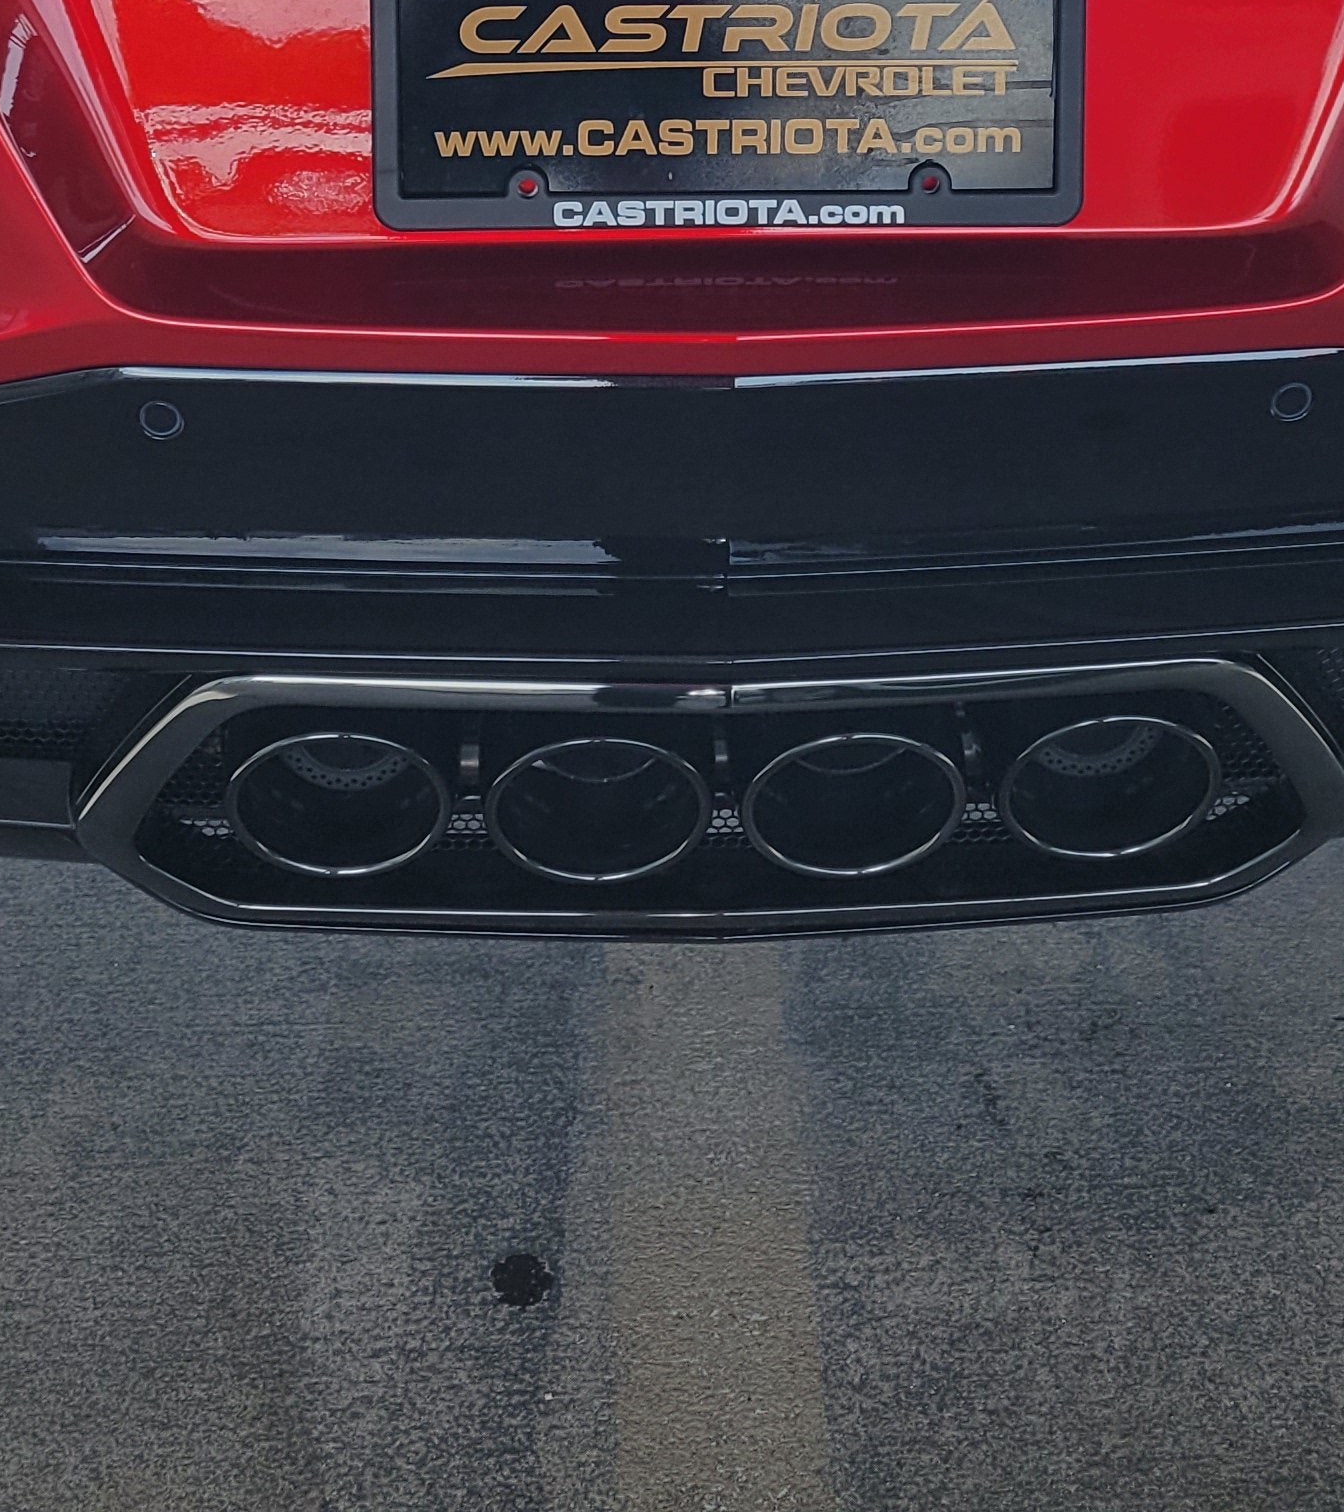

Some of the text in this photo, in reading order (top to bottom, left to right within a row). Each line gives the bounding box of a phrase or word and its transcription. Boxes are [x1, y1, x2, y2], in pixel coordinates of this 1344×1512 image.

[458, 2, 1018, 55] CASTRIOTA
[702, 65, 1011, 98] CHEVROLET
[433, 118, 1023, 158] www.CASTRIOTA.com
[552, 198, 907, 228] CASTRIOTA.com
